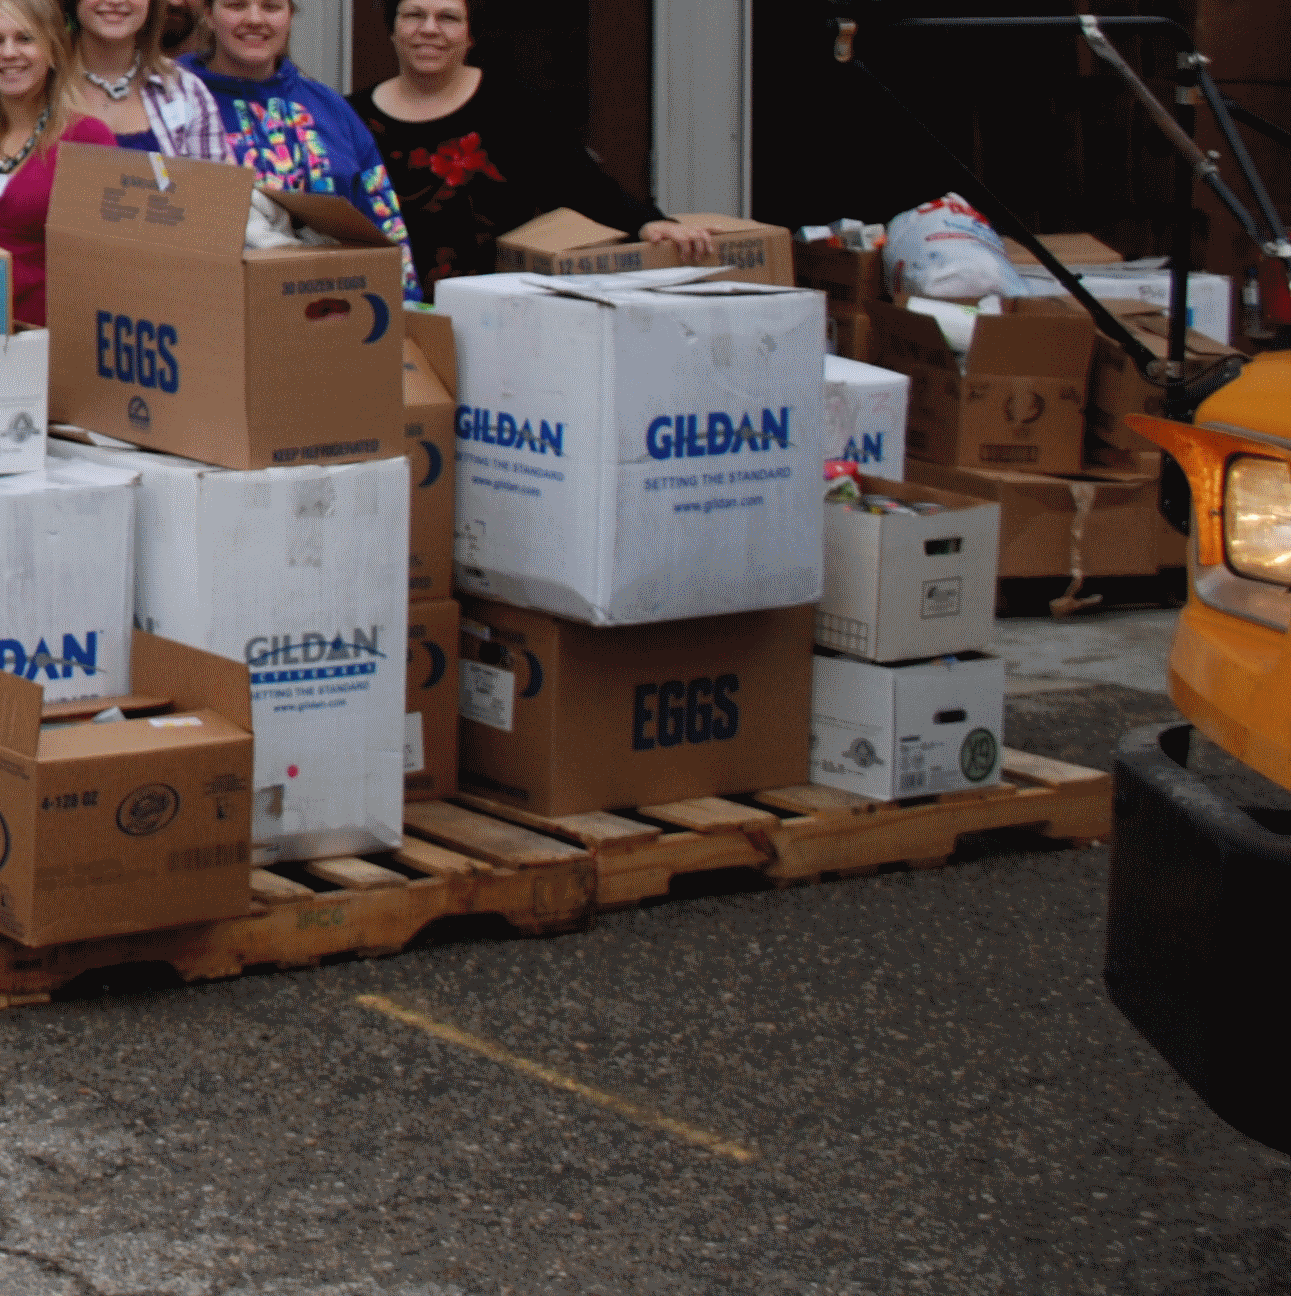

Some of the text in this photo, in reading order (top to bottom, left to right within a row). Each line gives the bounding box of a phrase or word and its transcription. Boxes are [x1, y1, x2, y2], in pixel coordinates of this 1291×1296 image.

[96, 310, 180, 394] EGGS
[455, 404, 563, 457] GILDAN
[647, 407, 789, 460] GILDAN
[644, 466, 791, 492] SETTING THE STANDARD
[244, 624, 378, 667] GILDAN
[295, 686, 315, 696] THE
[318, 680, 371, 695] STANDARD
[633, 674, 739, 751] EGGS
